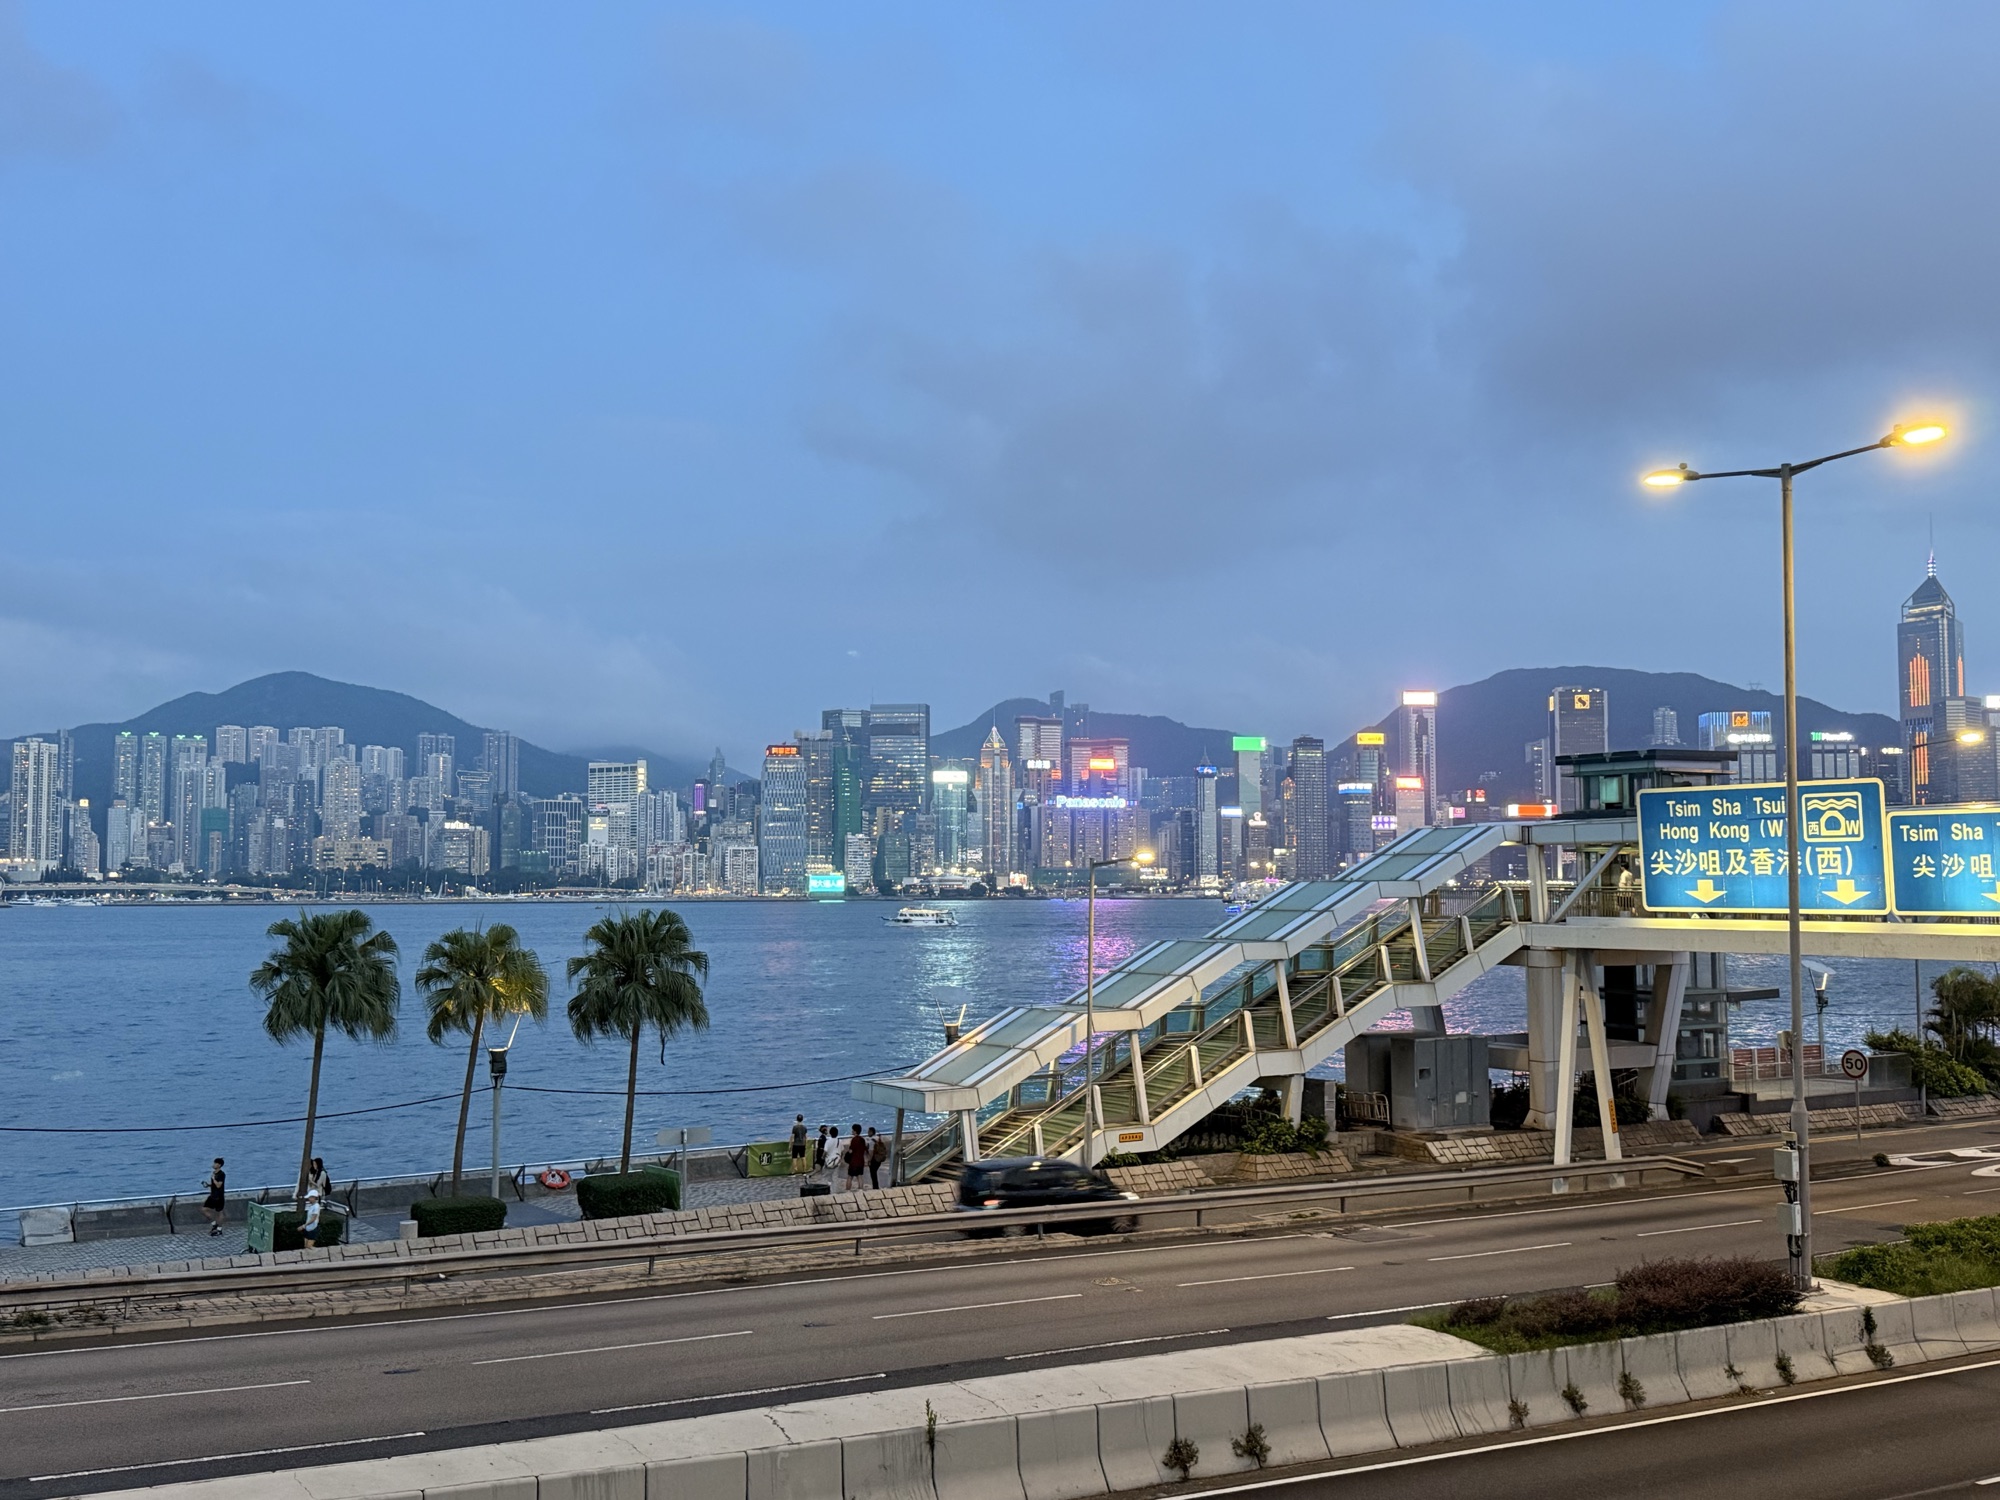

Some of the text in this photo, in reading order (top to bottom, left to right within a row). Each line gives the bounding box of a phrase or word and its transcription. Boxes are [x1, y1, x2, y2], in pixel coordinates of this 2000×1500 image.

[1056, 795, 1126, 808] Panasonic
[1666, 795, 1786, 817] Tsim Sha Tsui
[1660, 818, 1788, 844] Hong Kong (W
[1807, 821, 1820, 836] 西
[1845, 820, 1860, 835] W
[1899, 822, 1984, 842] Tsim Sha
[1913, 853, 1996, 878] 尖沙咀
[1845, 1057, 1864, 1071] 50
